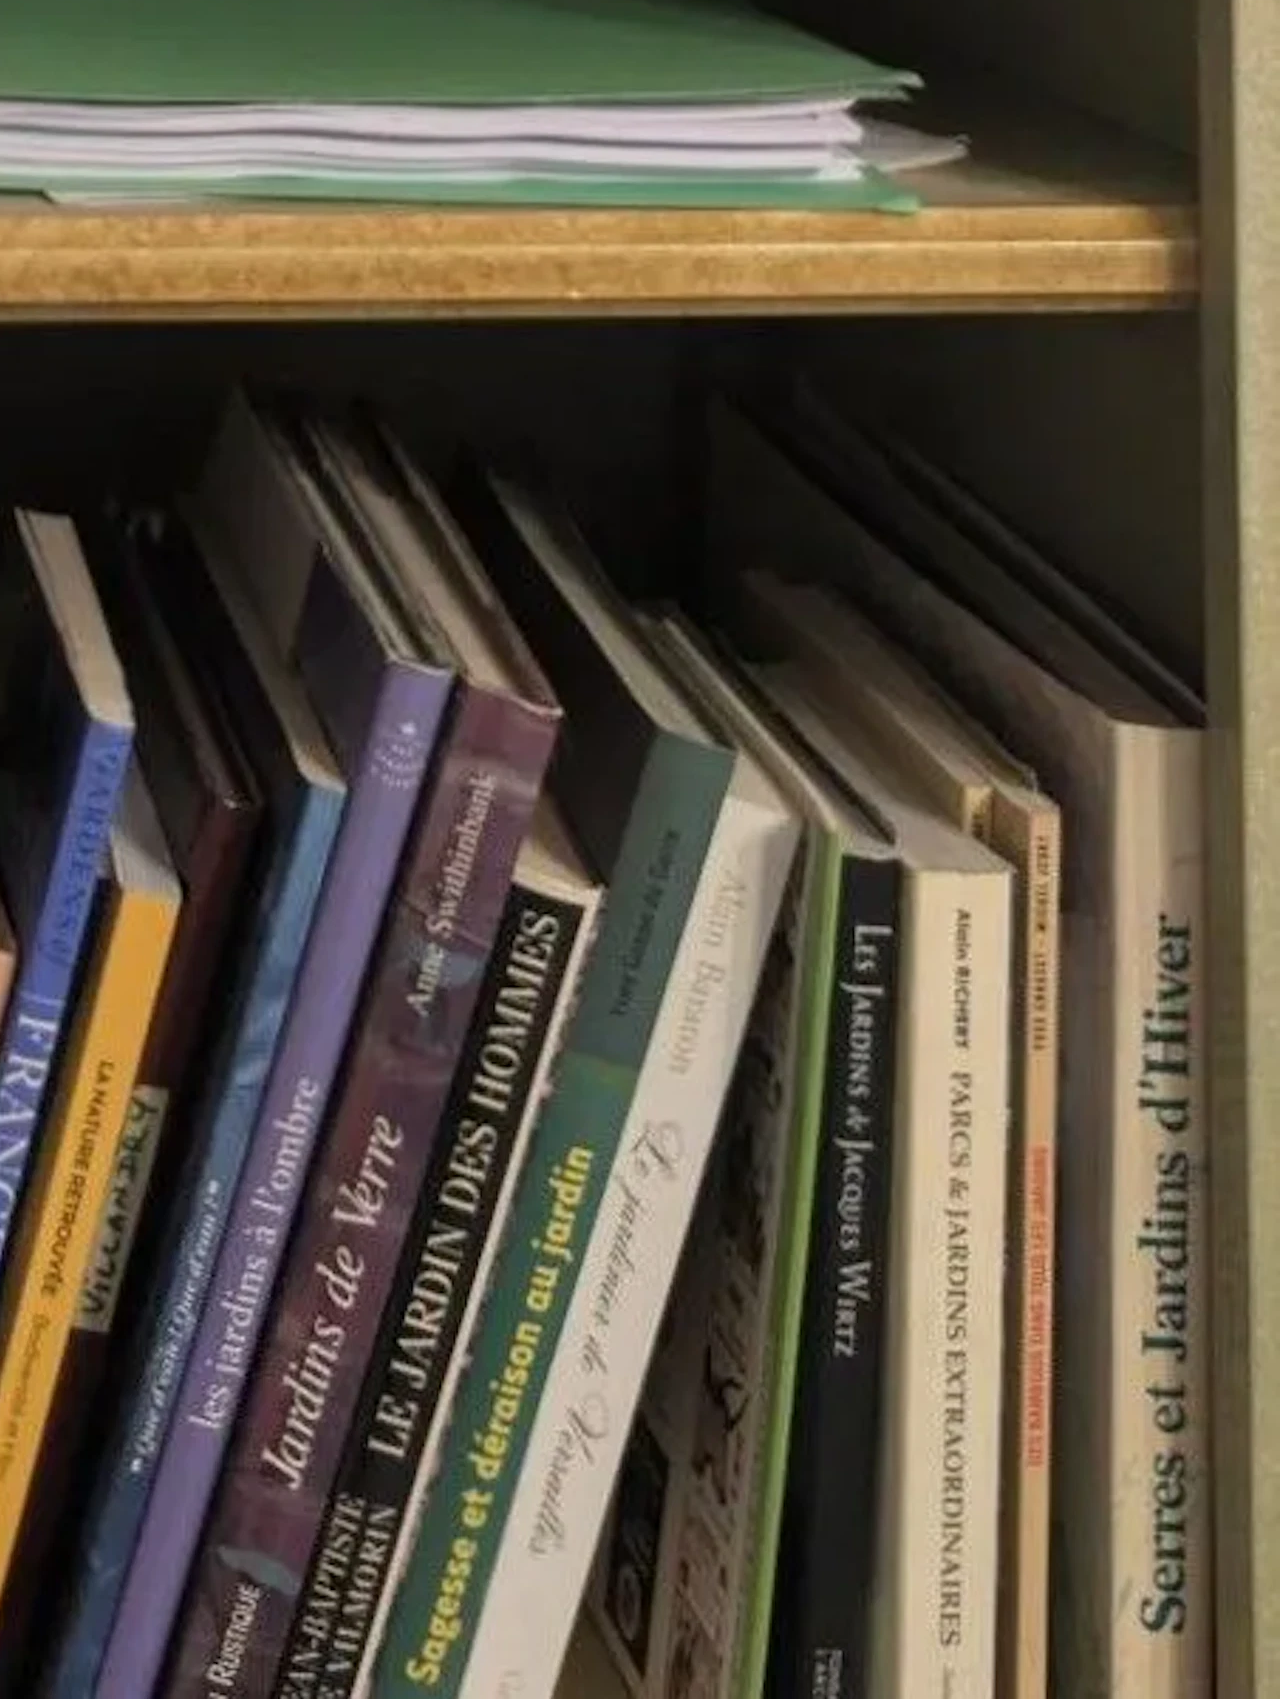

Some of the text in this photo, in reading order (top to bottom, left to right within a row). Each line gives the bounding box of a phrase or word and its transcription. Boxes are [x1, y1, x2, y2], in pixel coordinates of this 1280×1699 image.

[251, 1073, 321, 1208] l'ombre
[239, 1223, 278, 1244] à
[1136, 912, 1193, 1636] Serres et Jardins d'Hiver
[200, 1254, 271, 1377] jardins
[188, 1382, 230, 1430] les
[405, 1144, 596, 1686] Sagesse et déraison au jardin
